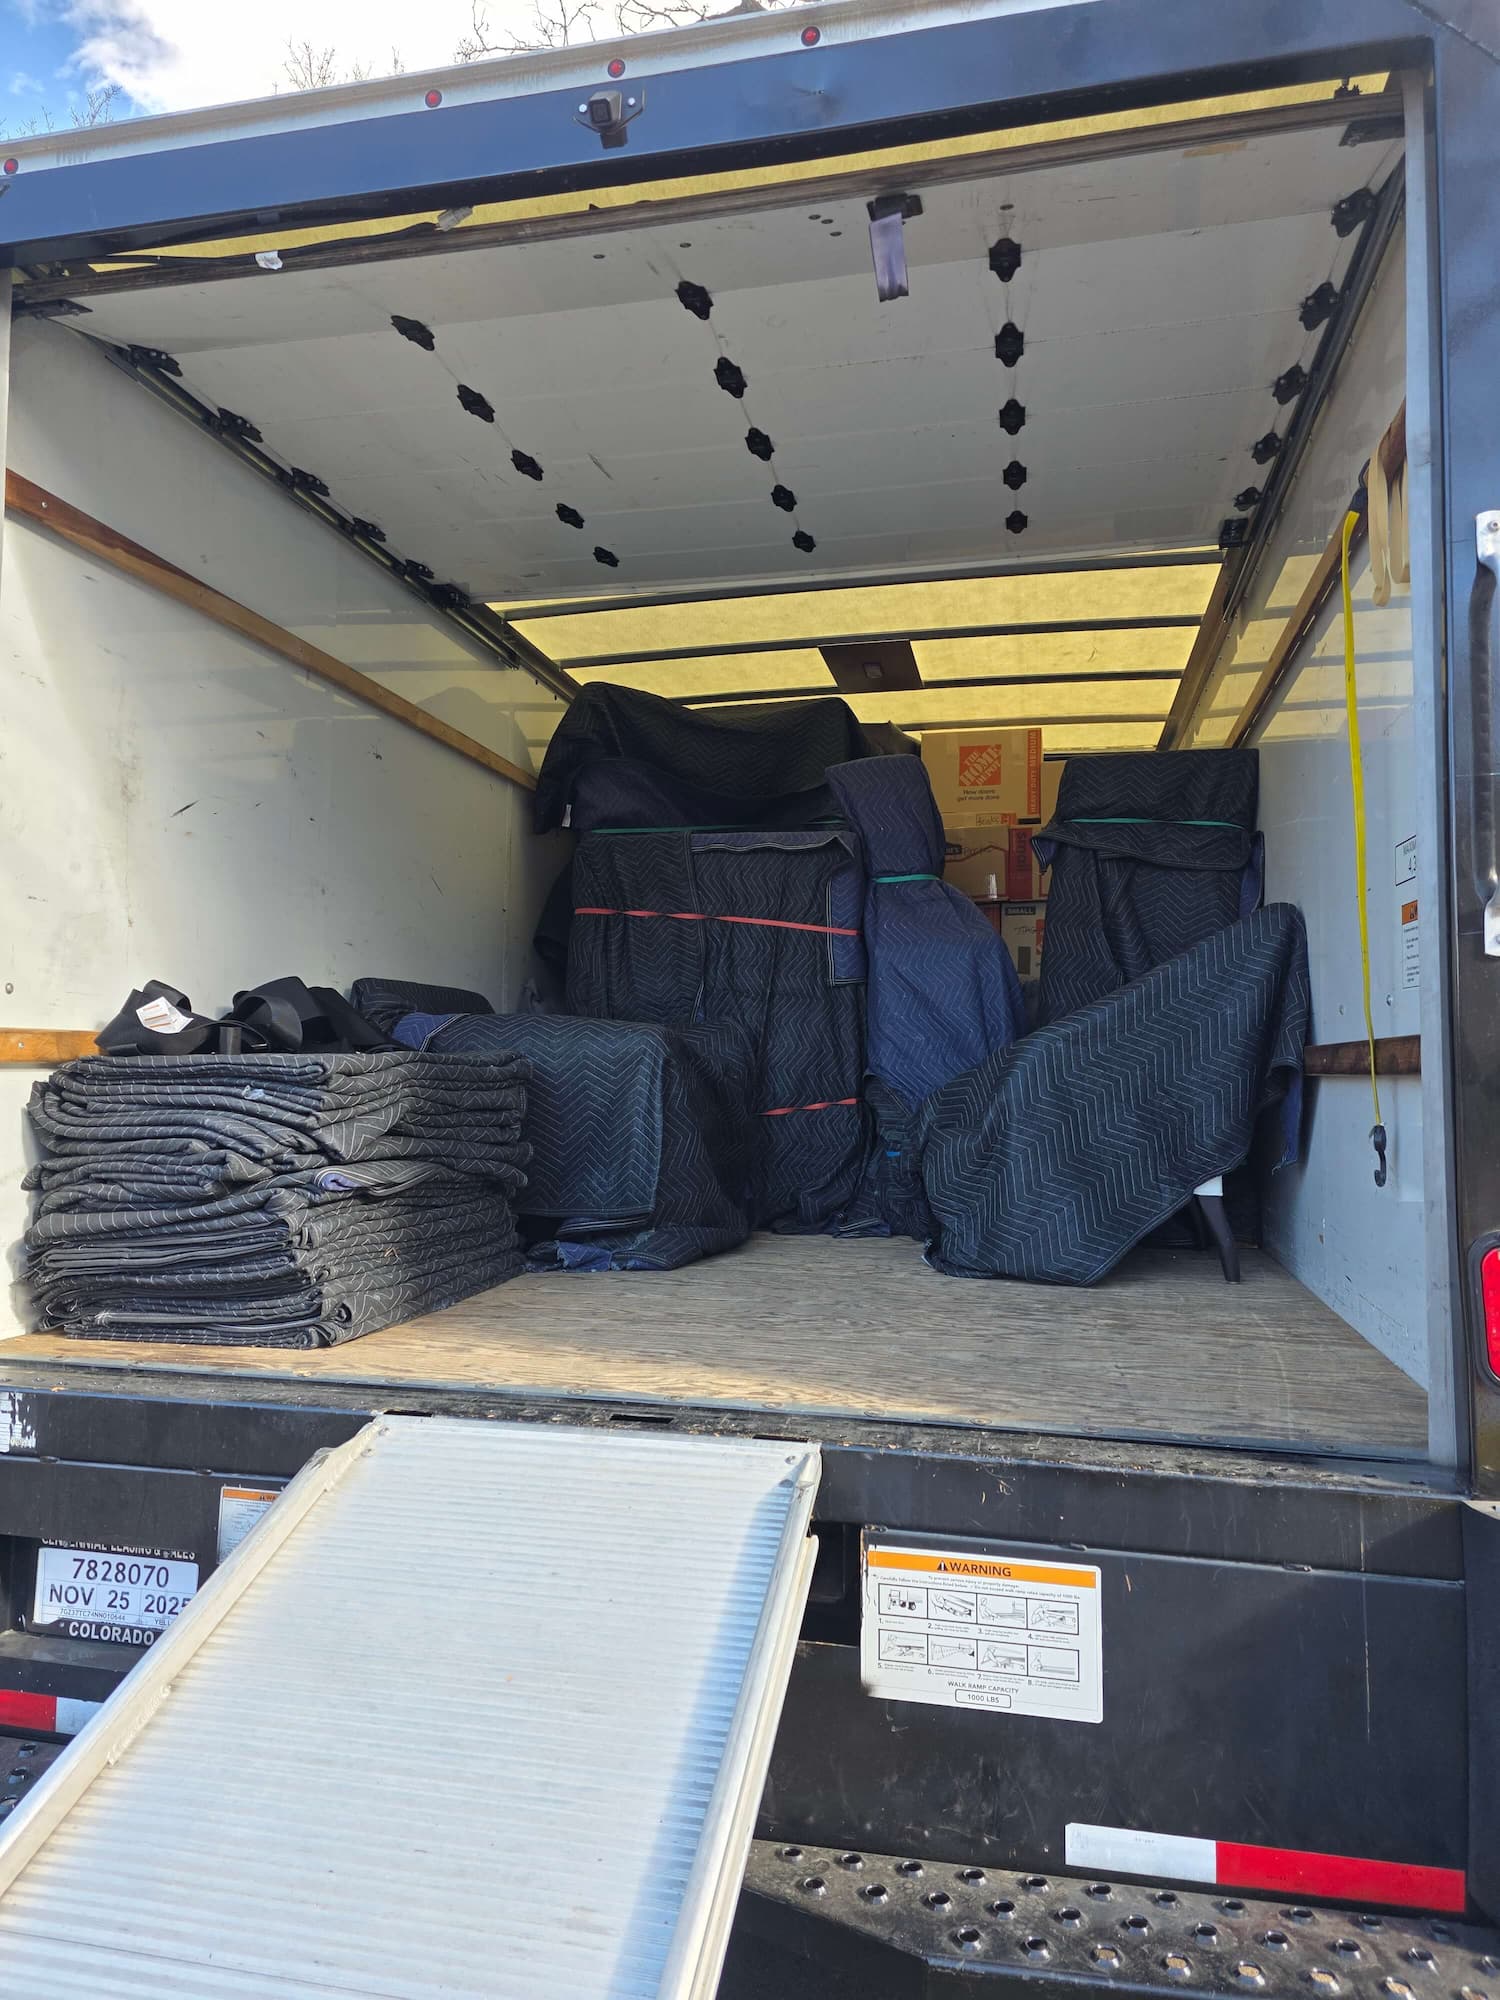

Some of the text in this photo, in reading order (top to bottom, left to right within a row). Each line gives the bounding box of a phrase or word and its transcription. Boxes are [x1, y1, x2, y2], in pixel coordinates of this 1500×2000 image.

[960, 746, 1001, 786] HOME
[964, 751, 979, 766] THE
[975, 759, 1001, 785] DEPOT
[72, 1558, 170, 1588] 7828070
[950, 1561, 1012, 1578] WARNING
[50, 1583, 95, 1606] NOV
[107, 1589, 130, 1610] 25
[69, 1621, 155, 1645] COLORADO
[967, 1694, 1000, 1704] 1000 LBS
[988, 1685, 1019, 1694] CAPACITY
